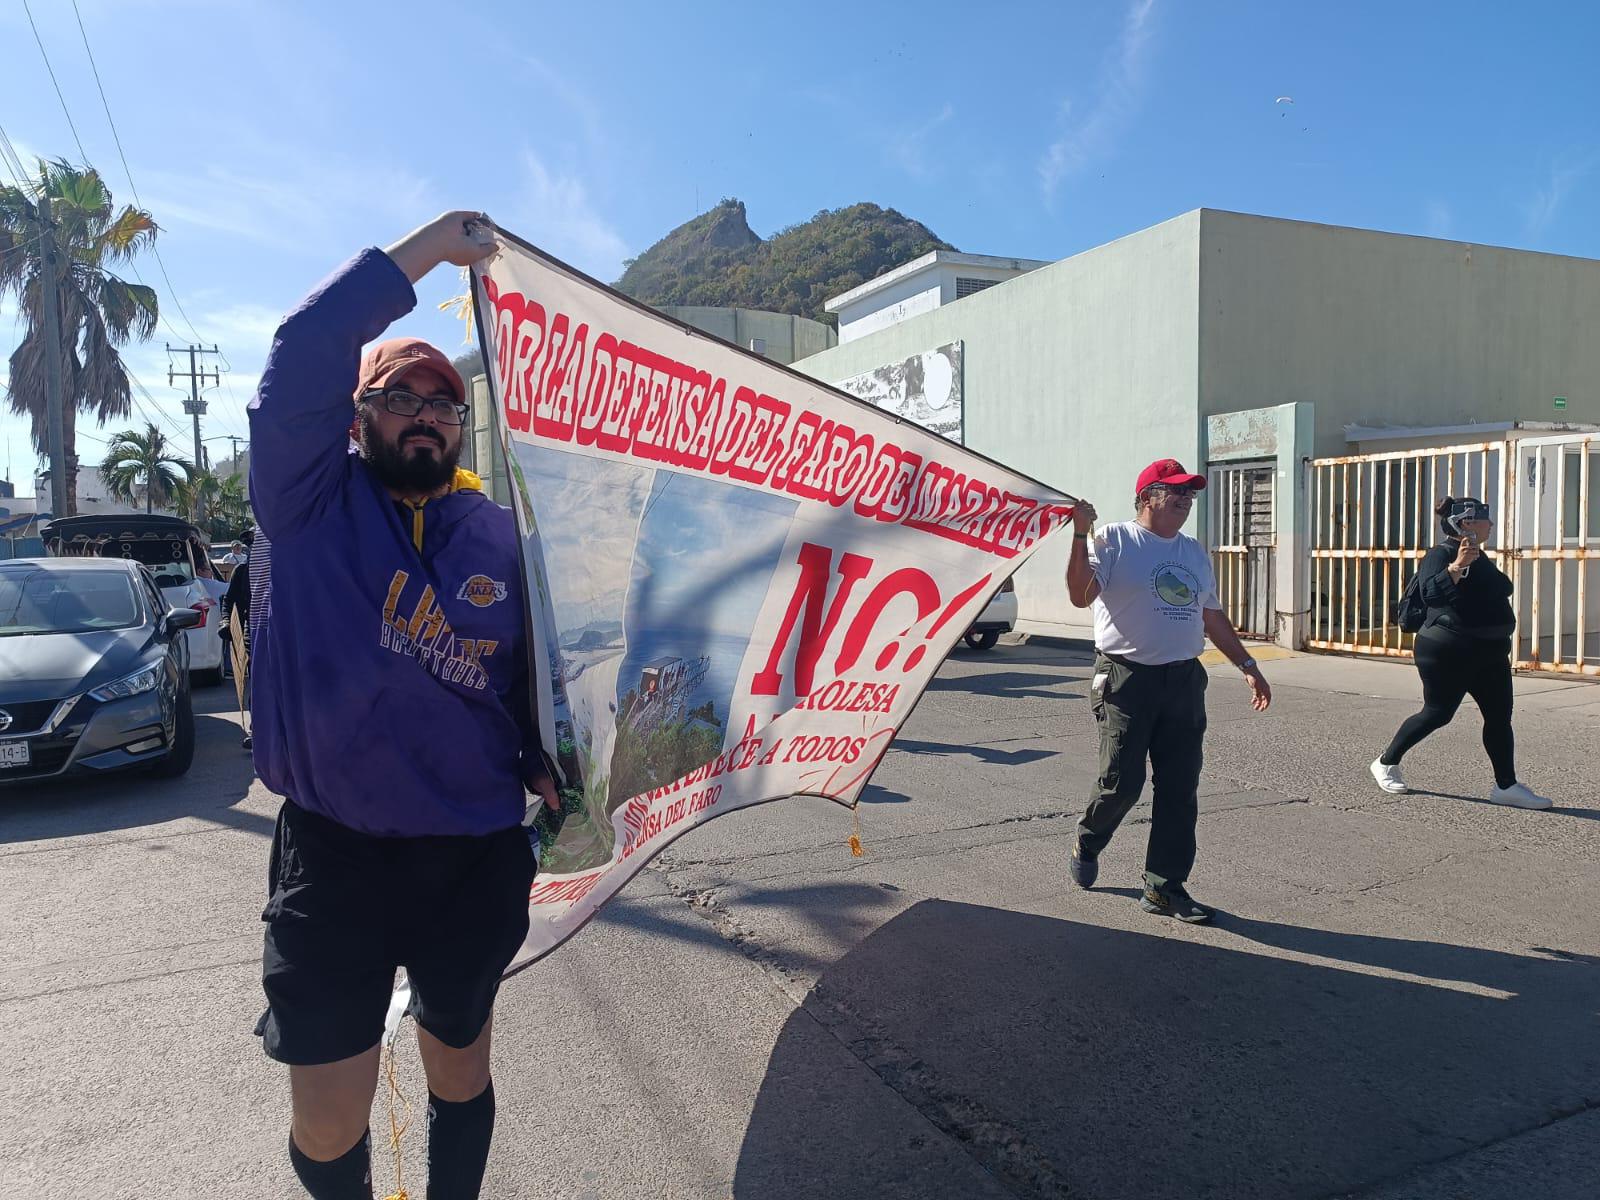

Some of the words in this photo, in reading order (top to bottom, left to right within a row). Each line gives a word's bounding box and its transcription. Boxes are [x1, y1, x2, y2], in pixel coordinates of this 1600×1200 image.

[531, 313, 590, 442] LA
[576, 332, 726, 471] DEFENSA
[710, 386, 791, 485] DEL
[770, 410, 875, 507] FARO
[854, 443, 922, 524] DE
[757, 738, 783, 766] A
[783, 735, 867, 764] TODOS
[664, 798, 687, 829] DEL
[688, 784, 723, 816] FARO
